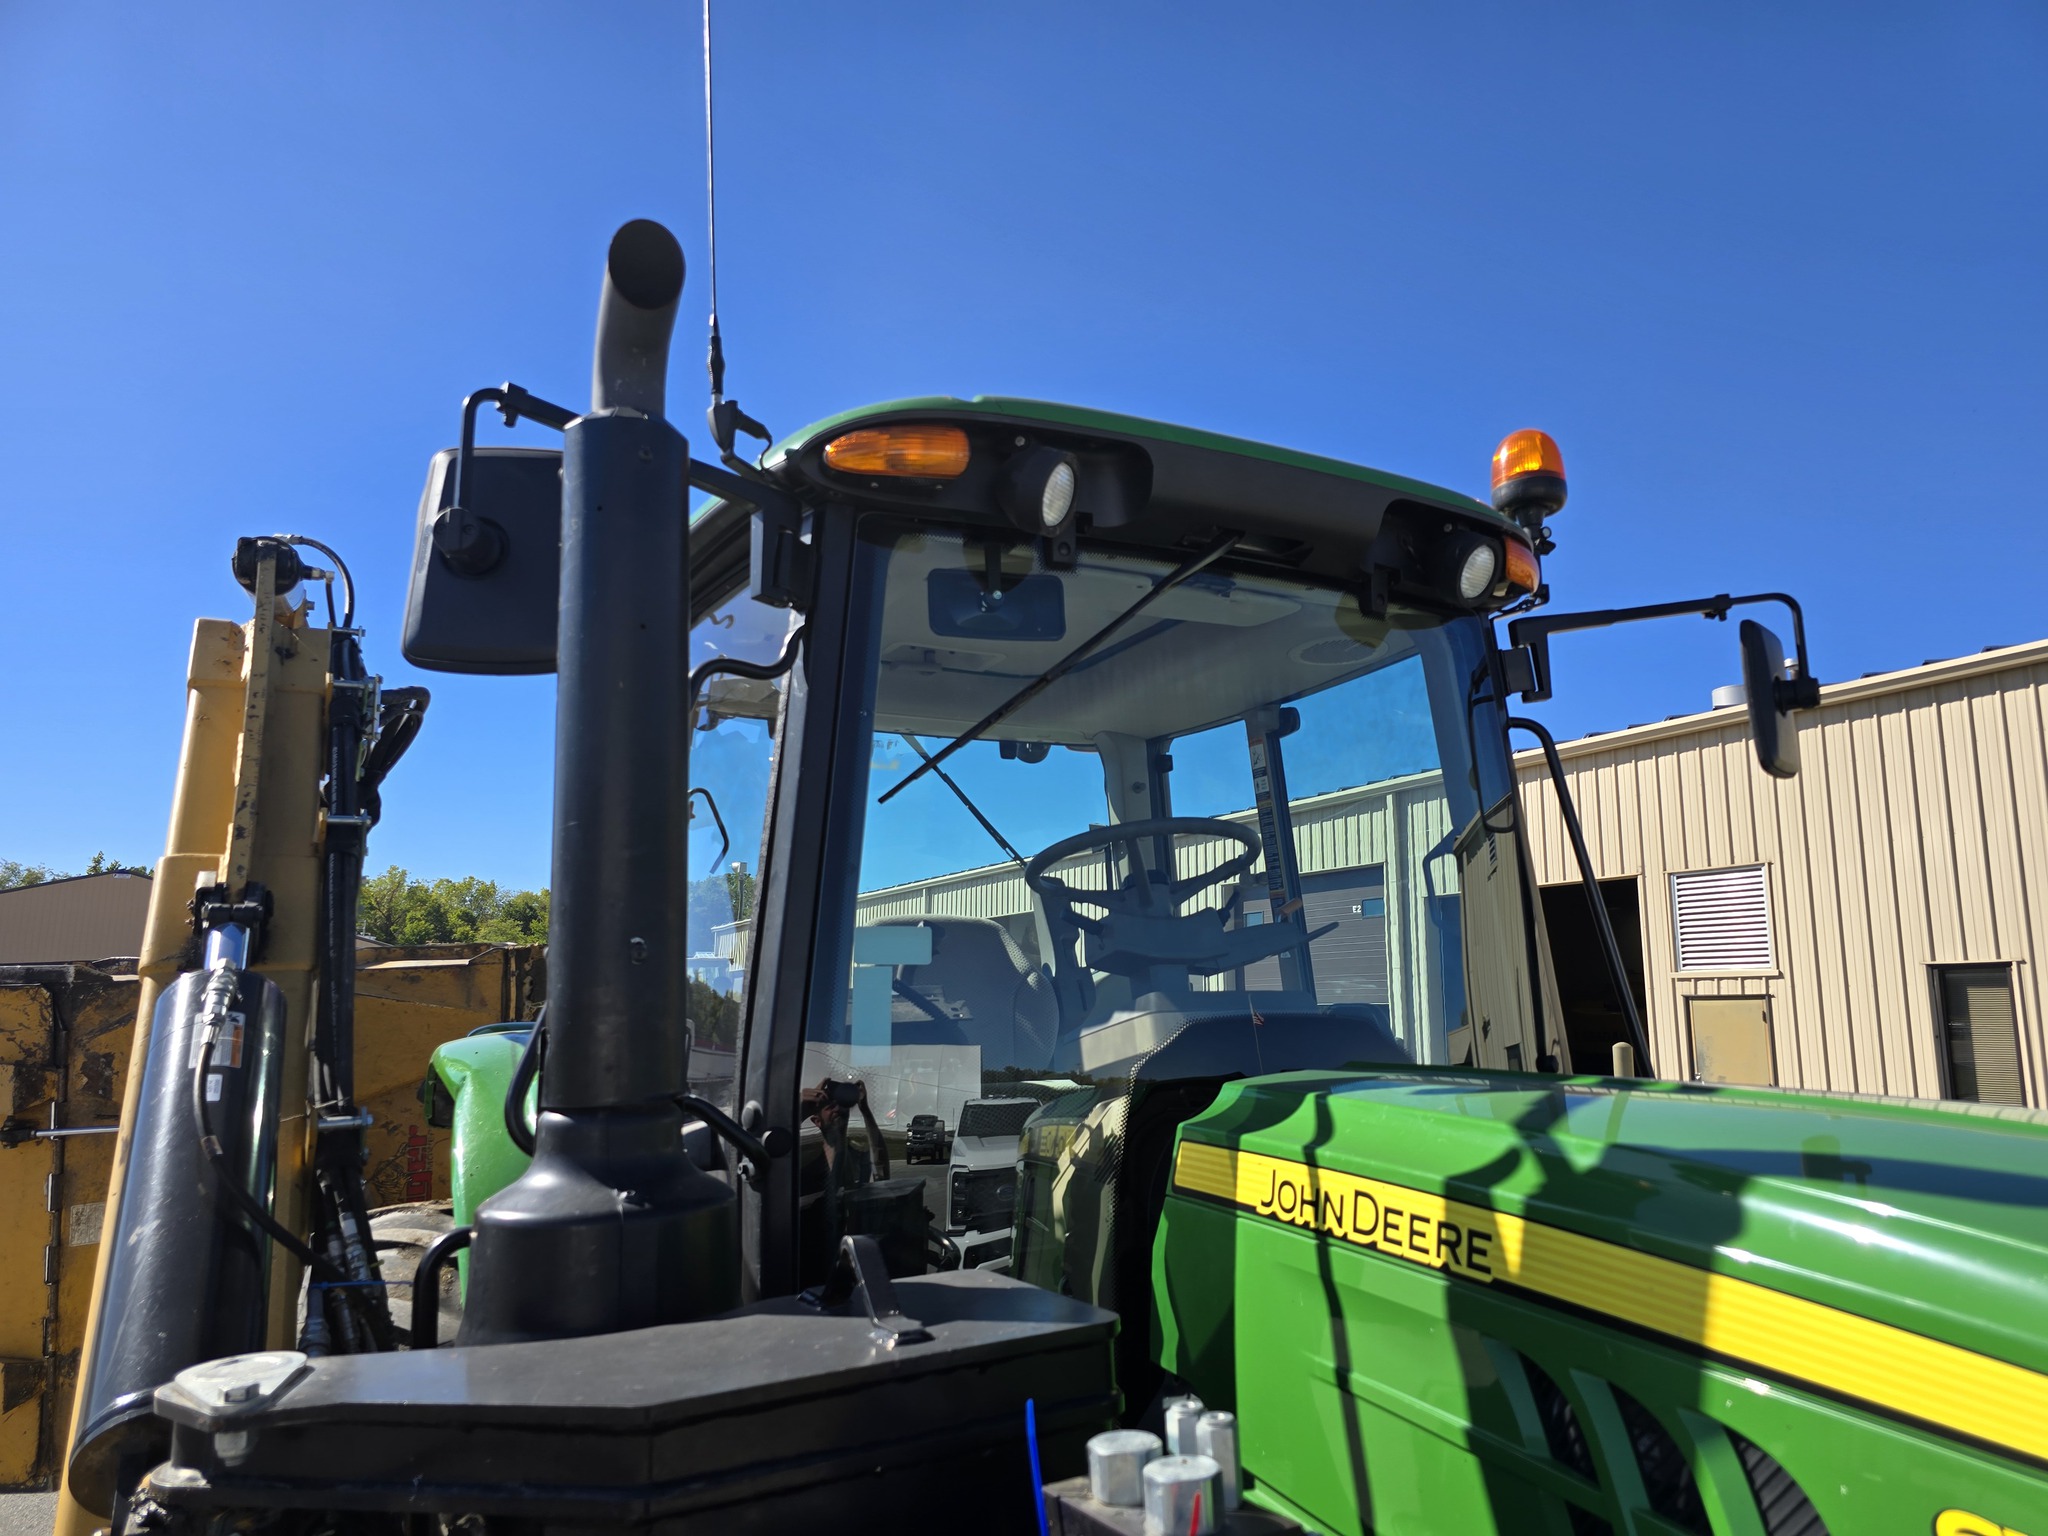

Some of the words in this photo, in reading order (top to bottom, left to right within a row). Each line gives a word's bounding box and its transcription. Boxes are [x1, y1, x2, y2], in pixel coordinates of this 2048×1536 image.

[1352, 904, 1362, 913] E2
[1260, 1169, 1344, 1229] JOHN
[1352, 1190, 1493, 1275] DEERE
